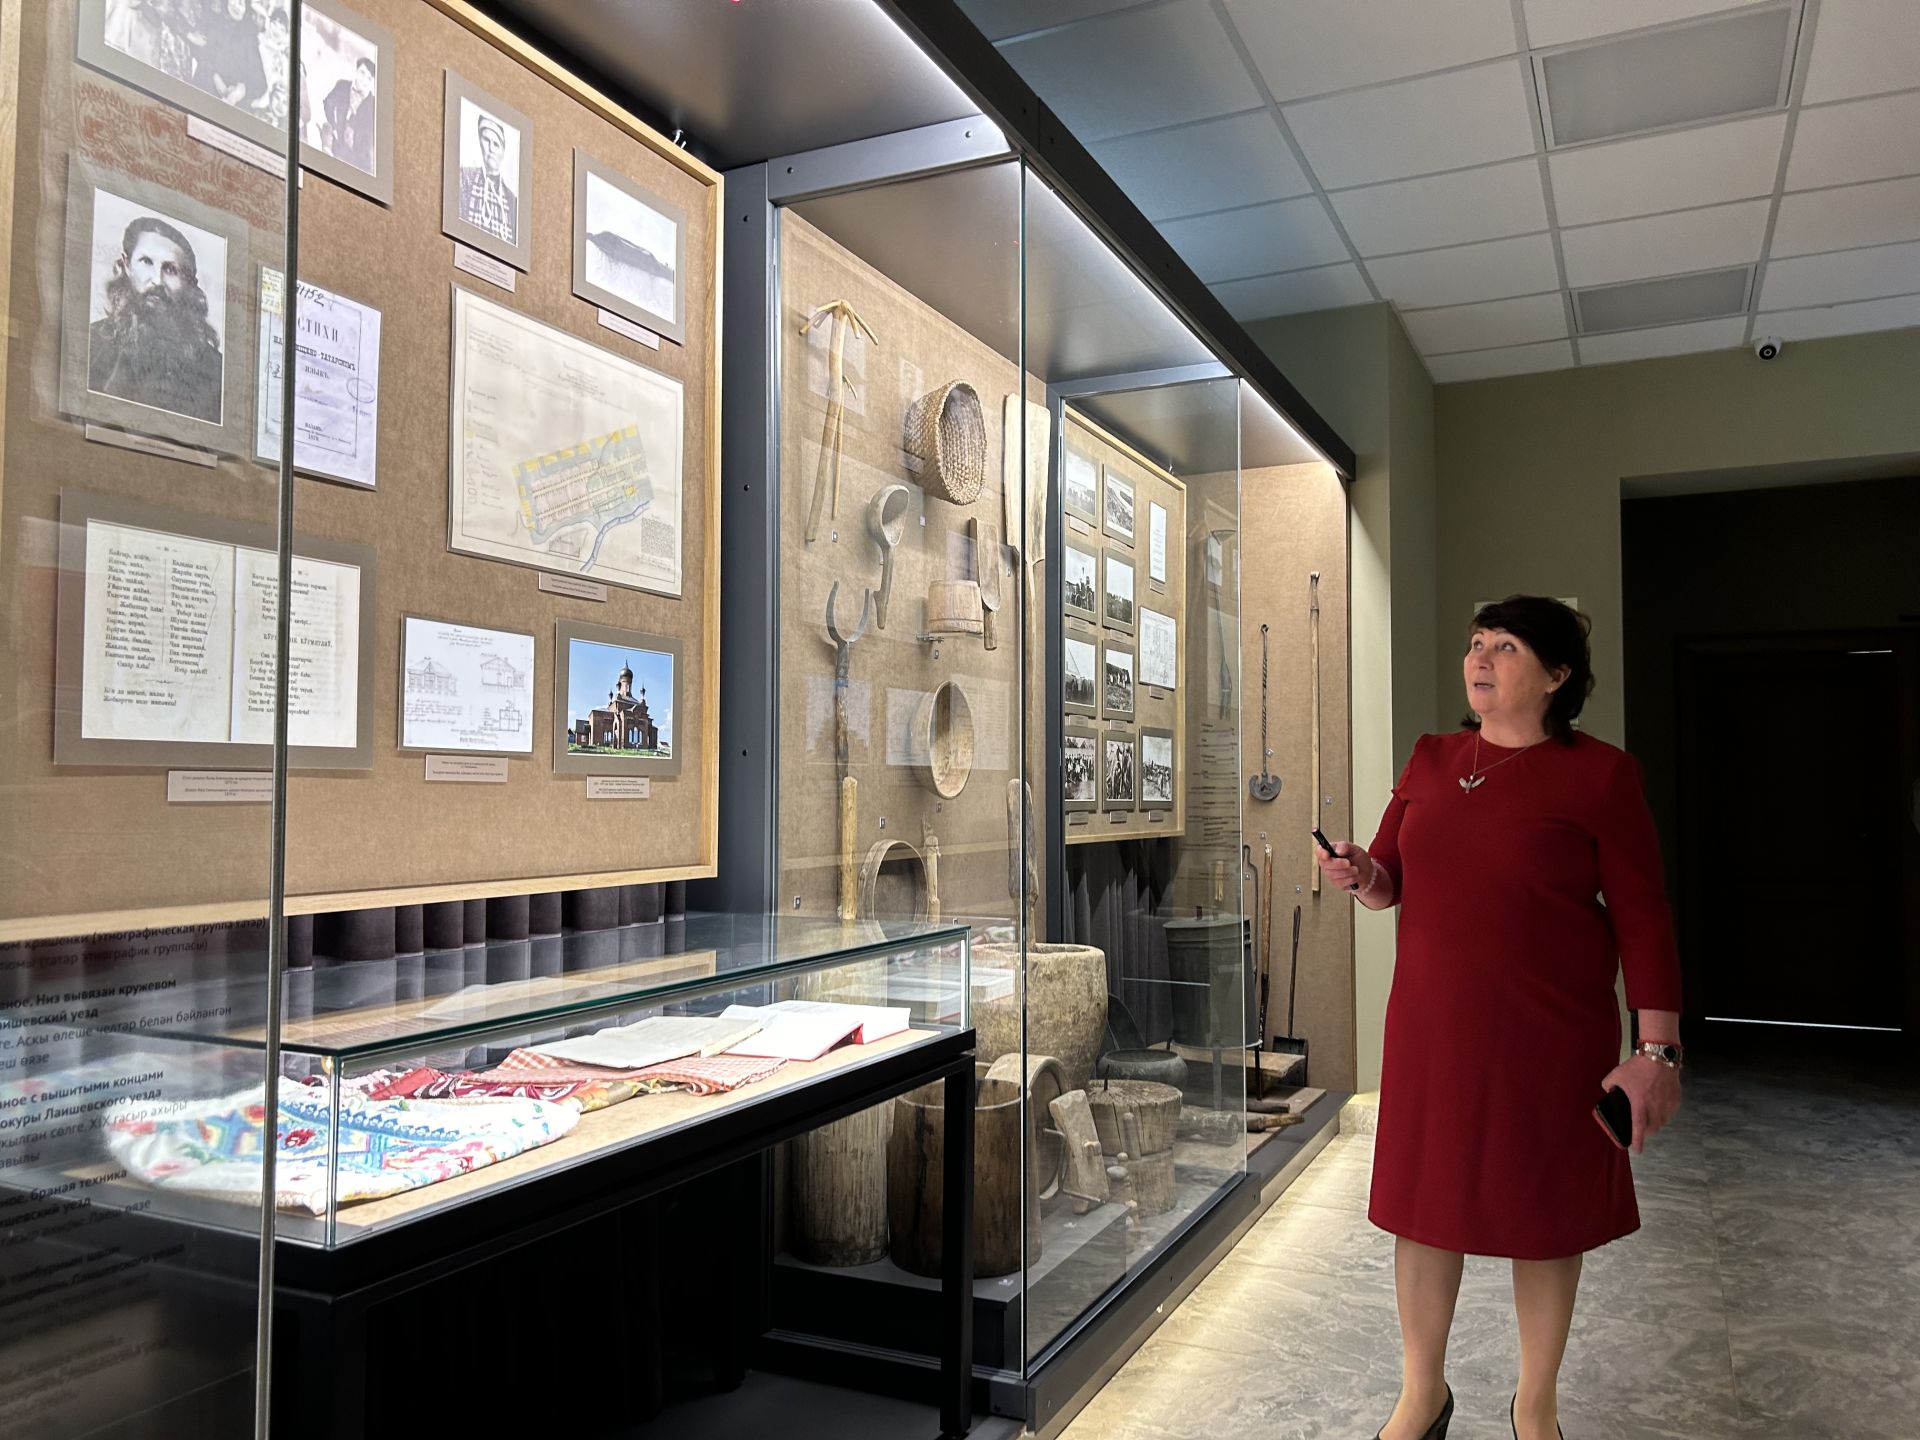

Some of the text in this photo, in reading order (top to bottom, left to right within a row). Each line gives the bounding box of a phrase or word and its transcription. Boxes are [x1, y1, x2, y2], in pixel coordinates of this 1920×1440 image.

[298, 316, 339, 343] СТИХИ
[36, 994, 60, 1006] Низ
[63, 987, 115, 1002] вывязан
[118, 979, 176, 998] кружевом
[70, 1007, 98, 1022] уезд
[16, 1033, 49, 1048] Аскы
[52, 1027, 92, 1043] өлеше
[20, 1052, 50, 1066] өязе
[30, 1094, 37, 1104] с
[41, 1082, 110, 1101] вышитыми
[113, 1070, 164, 1090] концами
[44, 1096, 126, 1121] Лаишевского
[128, 1088, 162, 1104] уезда
[113, 1110, 148, 1127] гасыр
[150, 1100, 188, 1118] ахыры
[79, 1169, 127, 1187] техника
